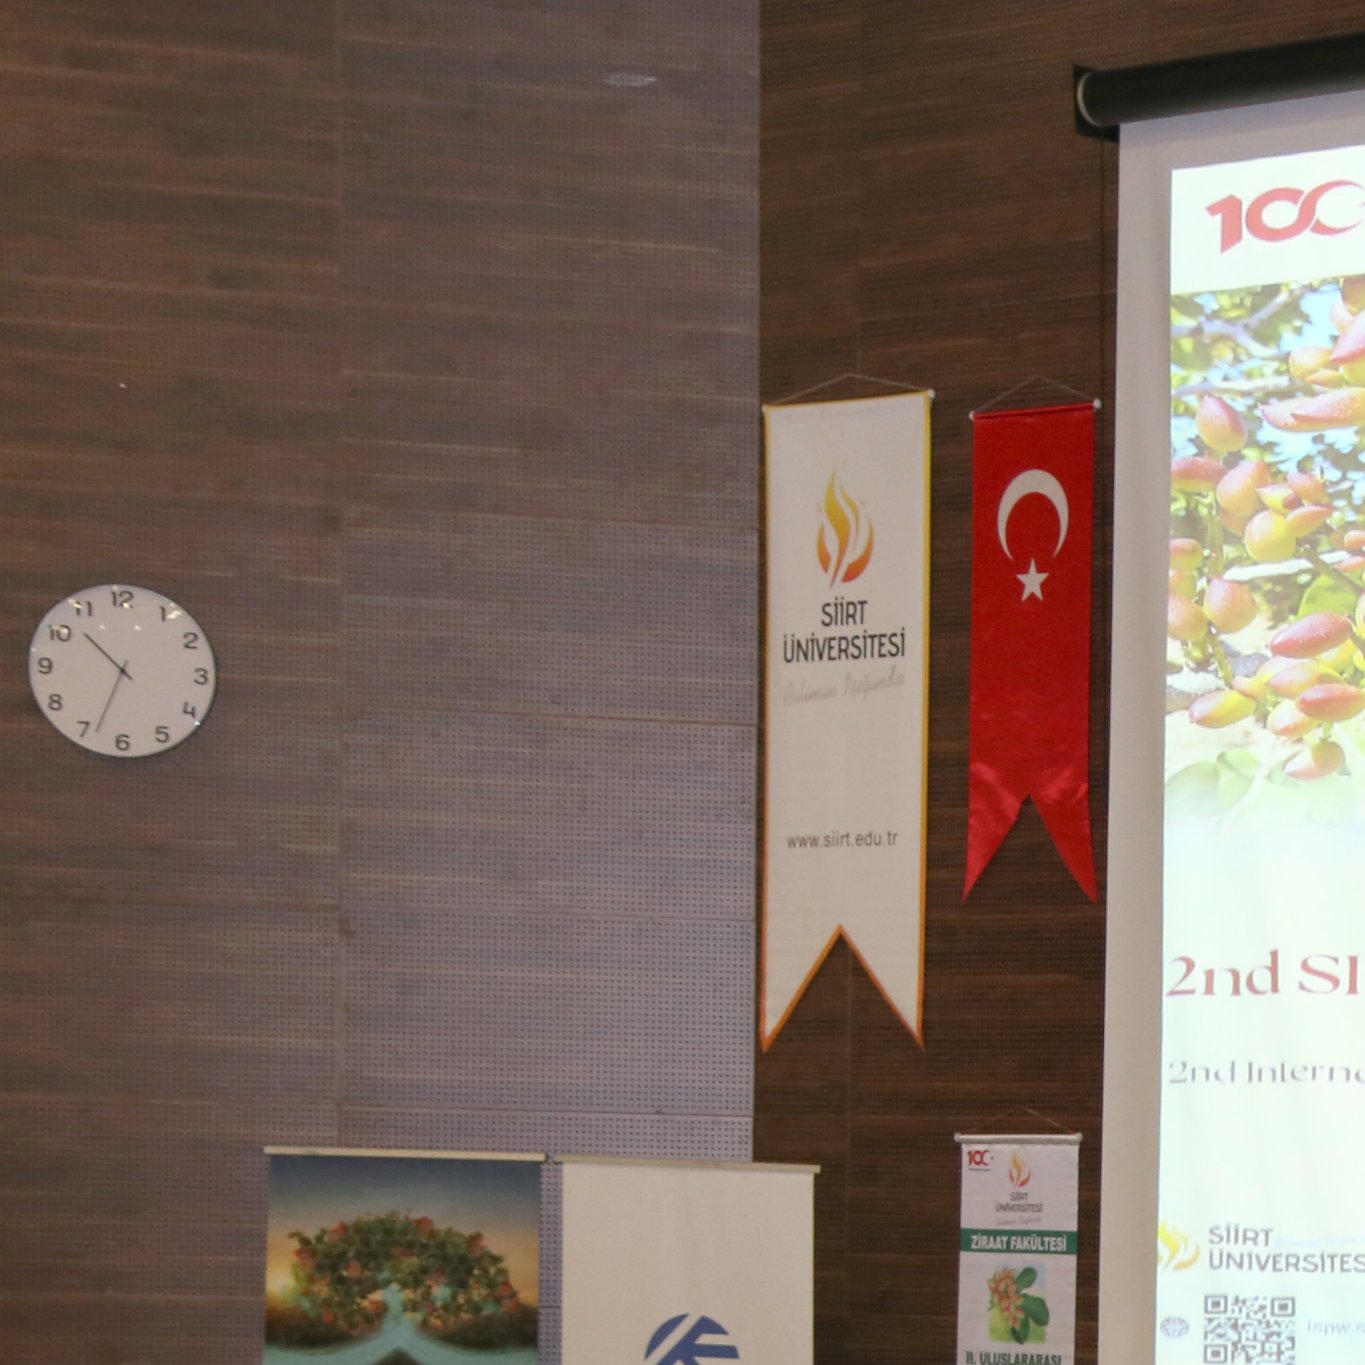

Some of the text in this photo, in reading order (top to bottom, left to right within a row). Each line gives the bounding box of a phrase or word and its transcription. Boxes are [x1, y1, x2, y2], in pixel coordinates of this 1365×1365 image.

[111, 590, 134, 608] 12
[49, 624, 72, 642] 10
[183, 632, 199, 649] 2
[783, 627, 905, 662] ÜNİVERSİTESİ
[37, 657, 53, 675] 9
[193, 667, 209, 685] 3
[48, 693, 63, 711] 8
[182, 701, 196, 718] 4
[77, 720, 90, 738] 7
[155, 726, 170, 743] 5
[115, 734, 130, 751] 6
[787, 831, 898, 848] www.siirt.edu.tr
[1166, 949, 1280, 997] 2nd
[1169, 1059, 1236, 1083] 2nd
[971, 1234, 1066, 1252] ZİRAAT FAKÜLTESİ
